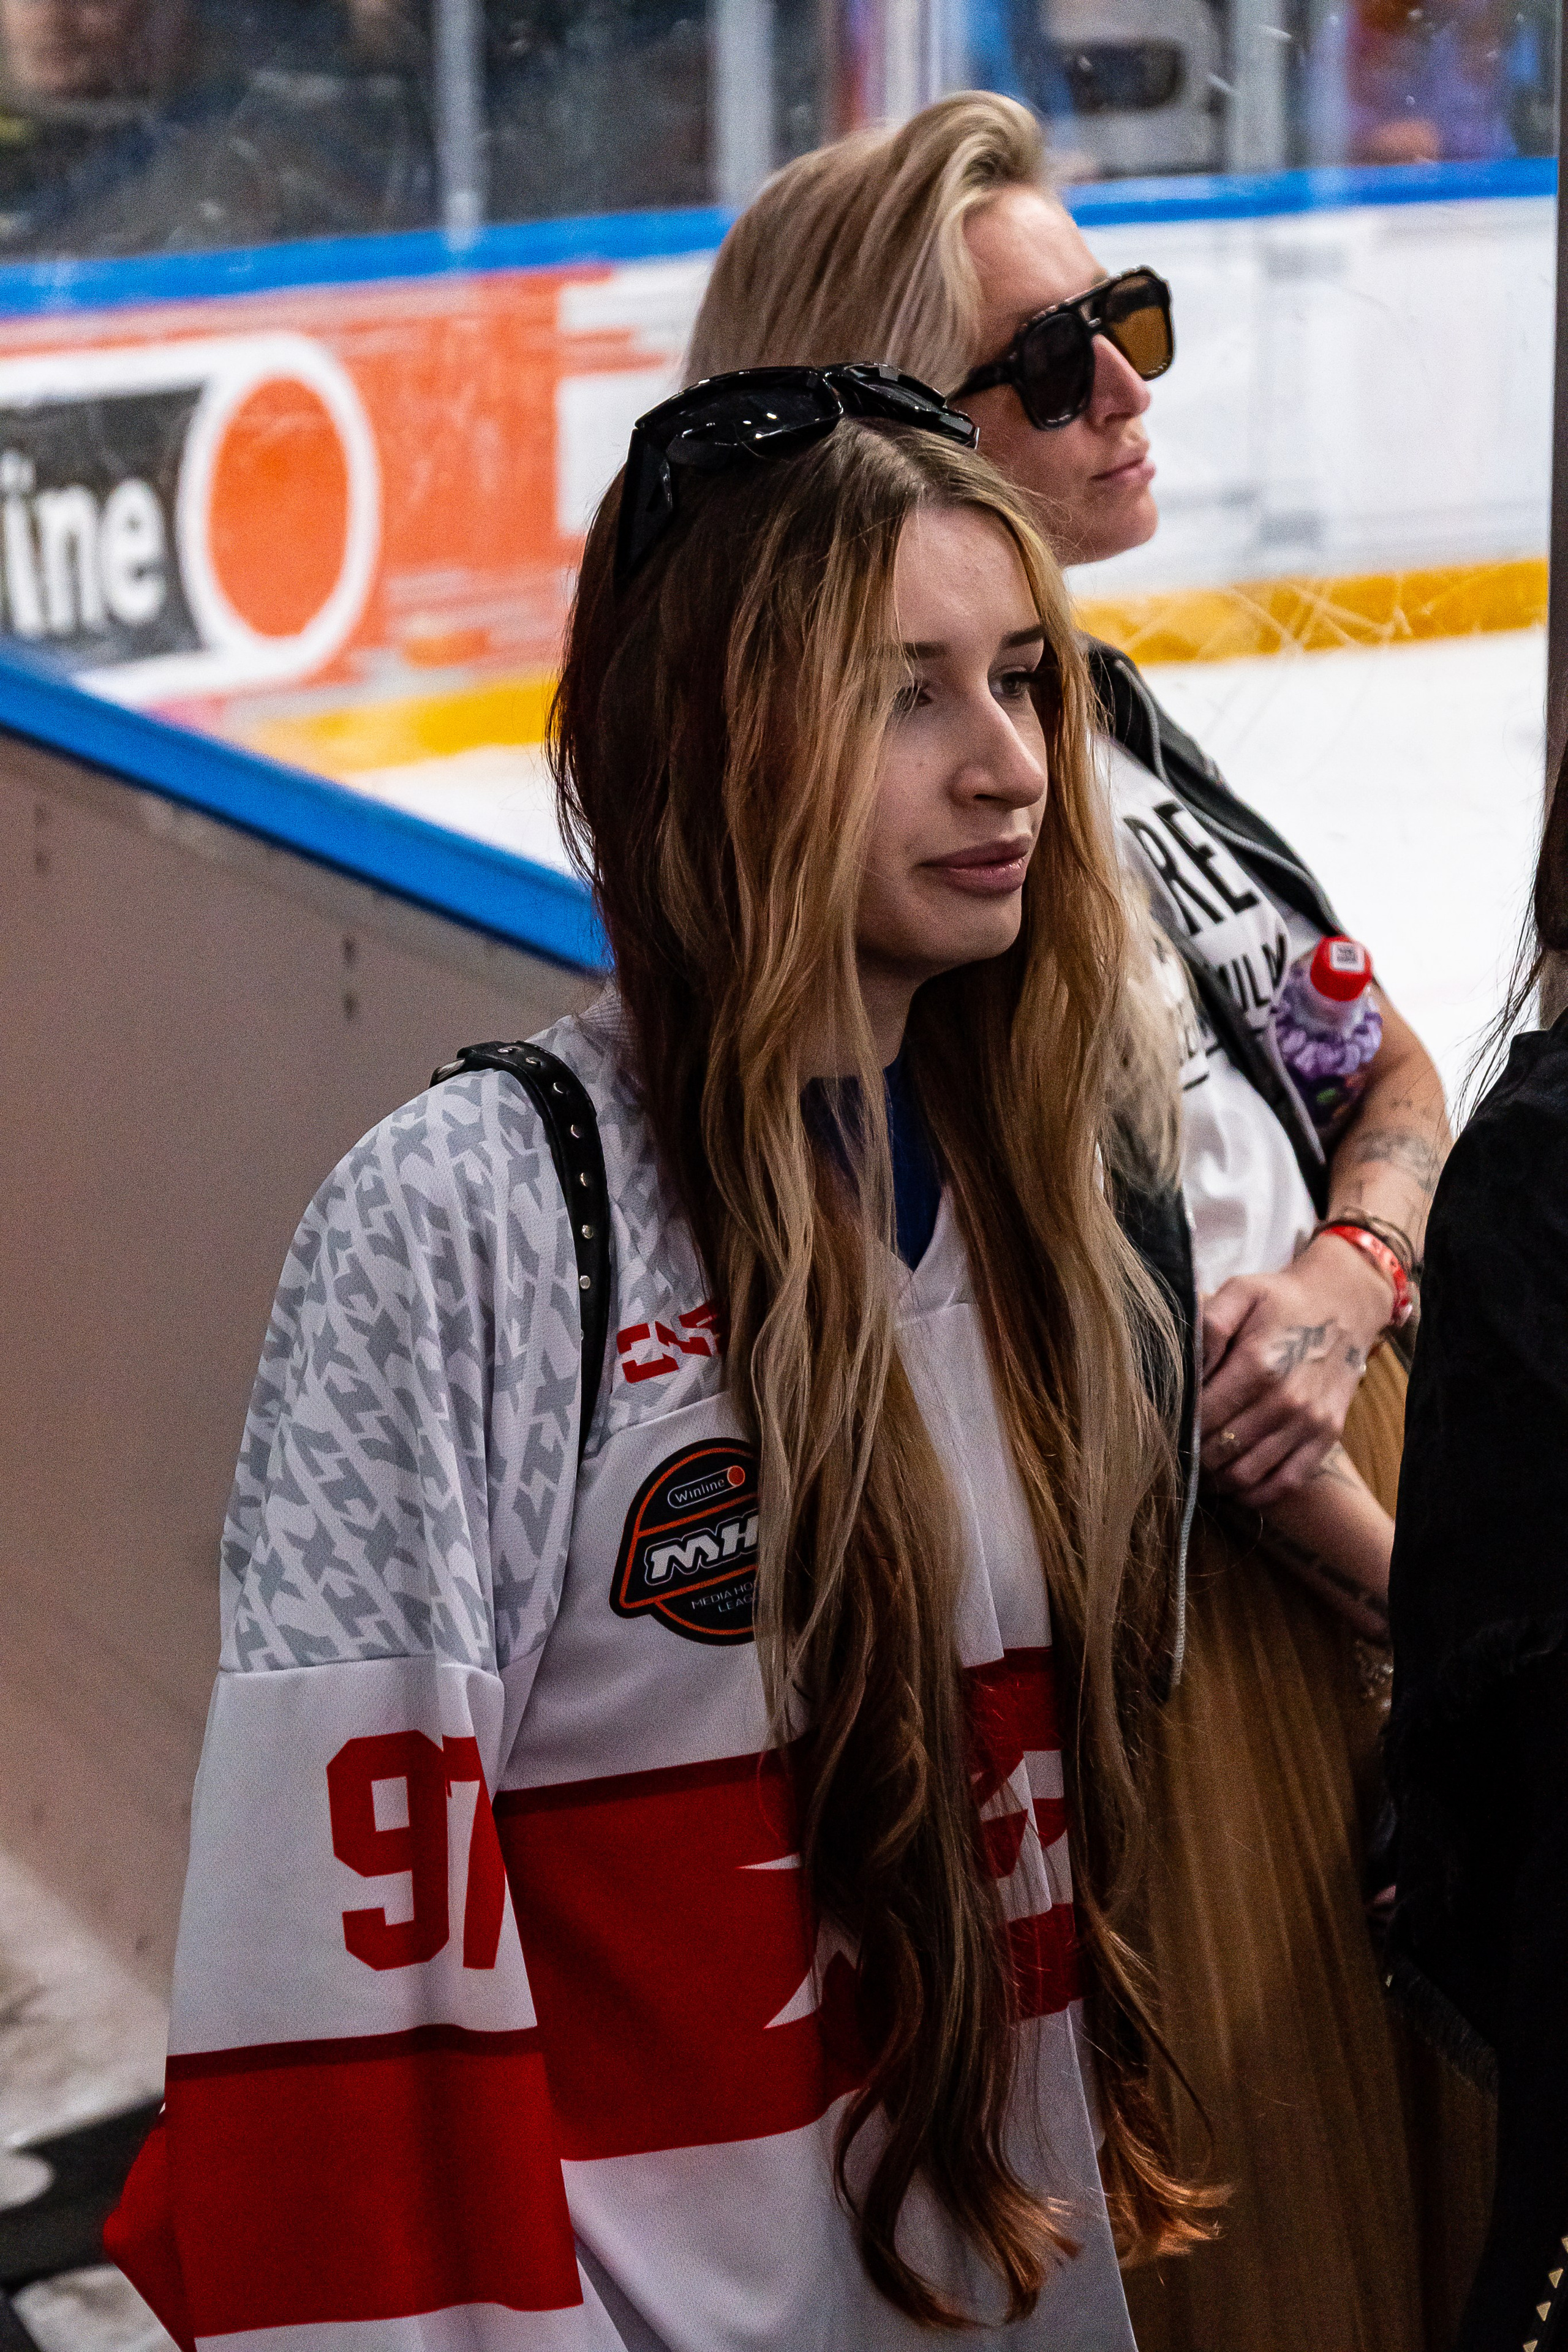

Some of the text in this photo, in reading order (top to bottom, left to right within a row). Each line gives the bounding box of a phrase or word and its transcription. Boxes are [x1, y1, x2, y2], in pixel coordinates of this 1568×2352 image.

[0, 450, 165, 634] ine
[674, 1479, 725, 1502] Winline
[650, 1514, 760, 1579] MH
[691, 1581, 753, 1610] MEDIA HO
[717, 1594, 754, 1613] LEAG
[326, 1729, 507, 1971] 97
